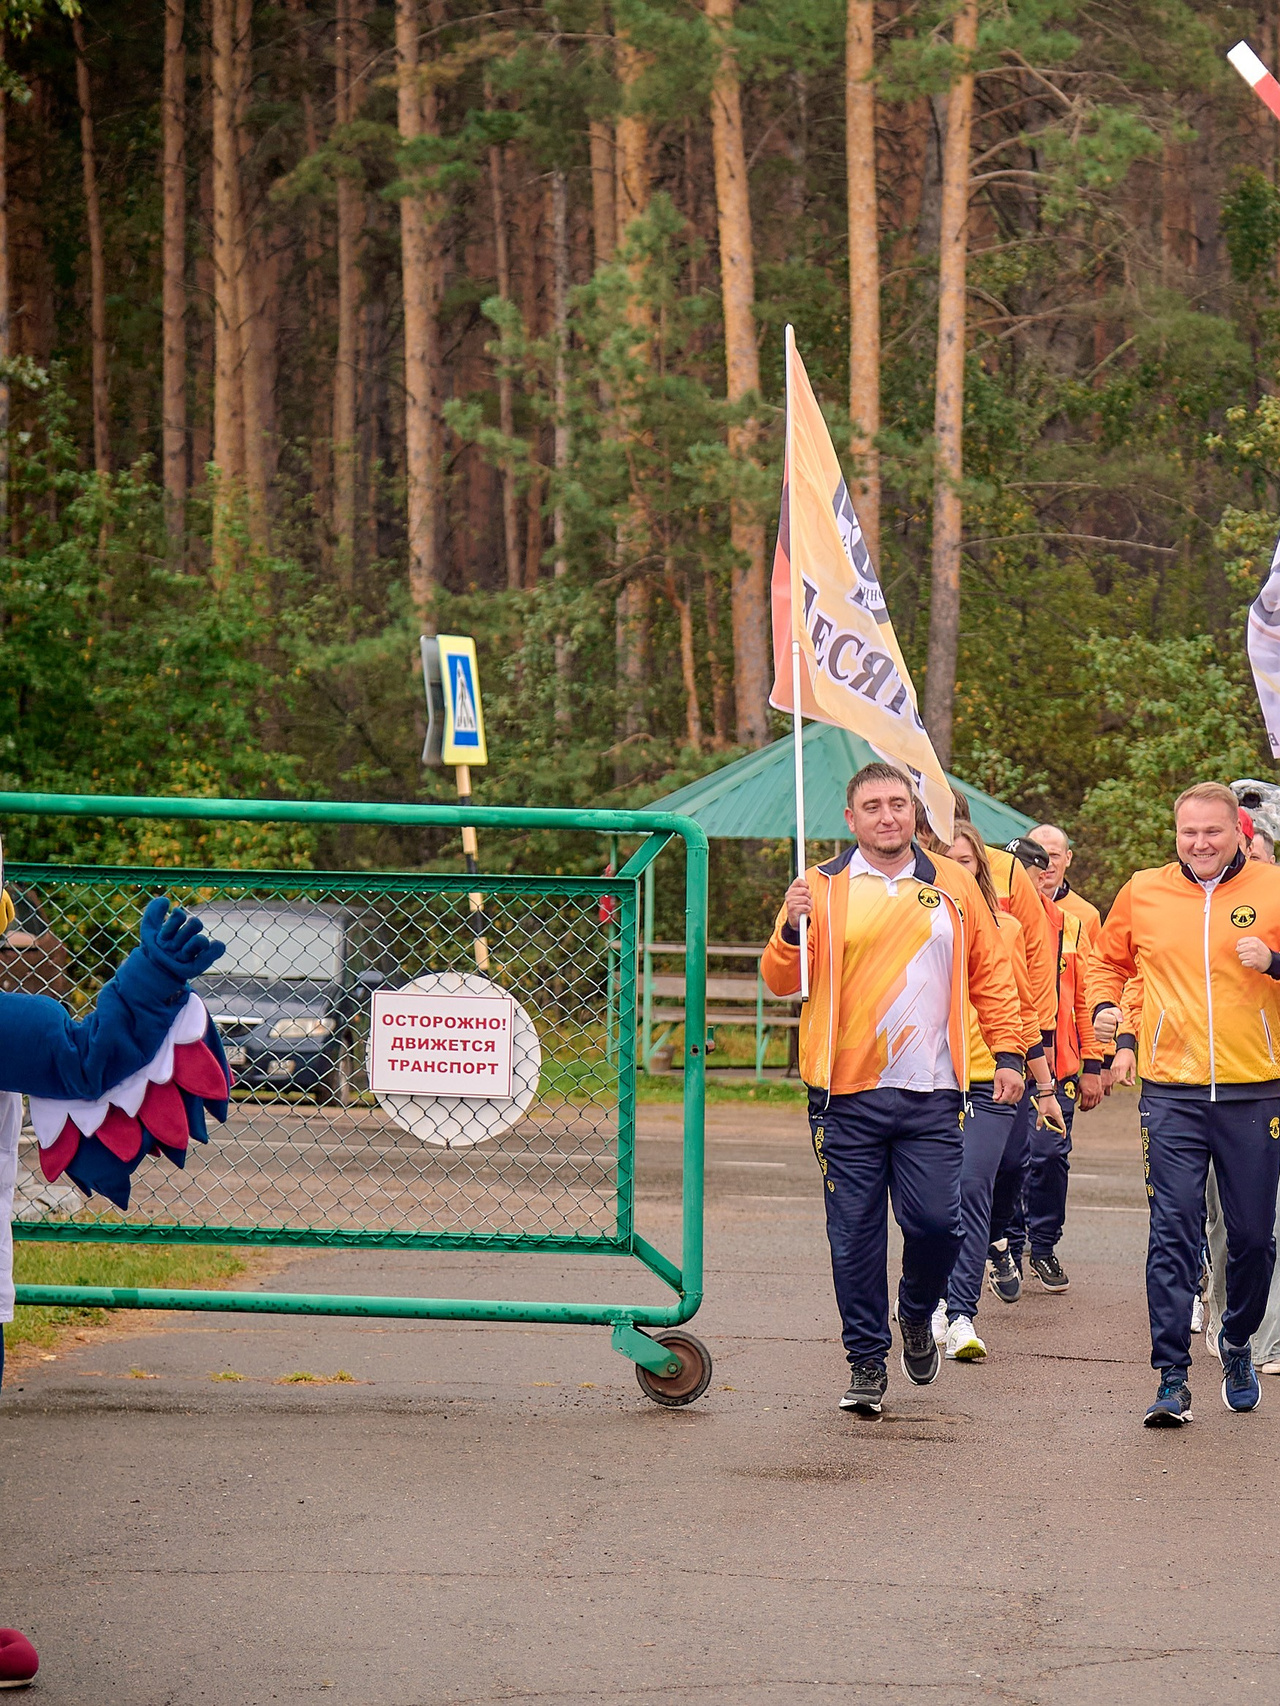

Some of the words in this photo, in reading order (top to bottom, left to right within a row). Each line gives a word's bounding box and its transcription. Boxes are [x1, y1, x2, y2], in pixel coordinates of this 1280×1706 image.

[382, 1013, 507, 1031] ОСТОРОЖНО!
[391, 1036, 496, 1053] ДВИЖЕТСЯ
[388, 1058, 499, 1075] ТРАНСПОРТ
